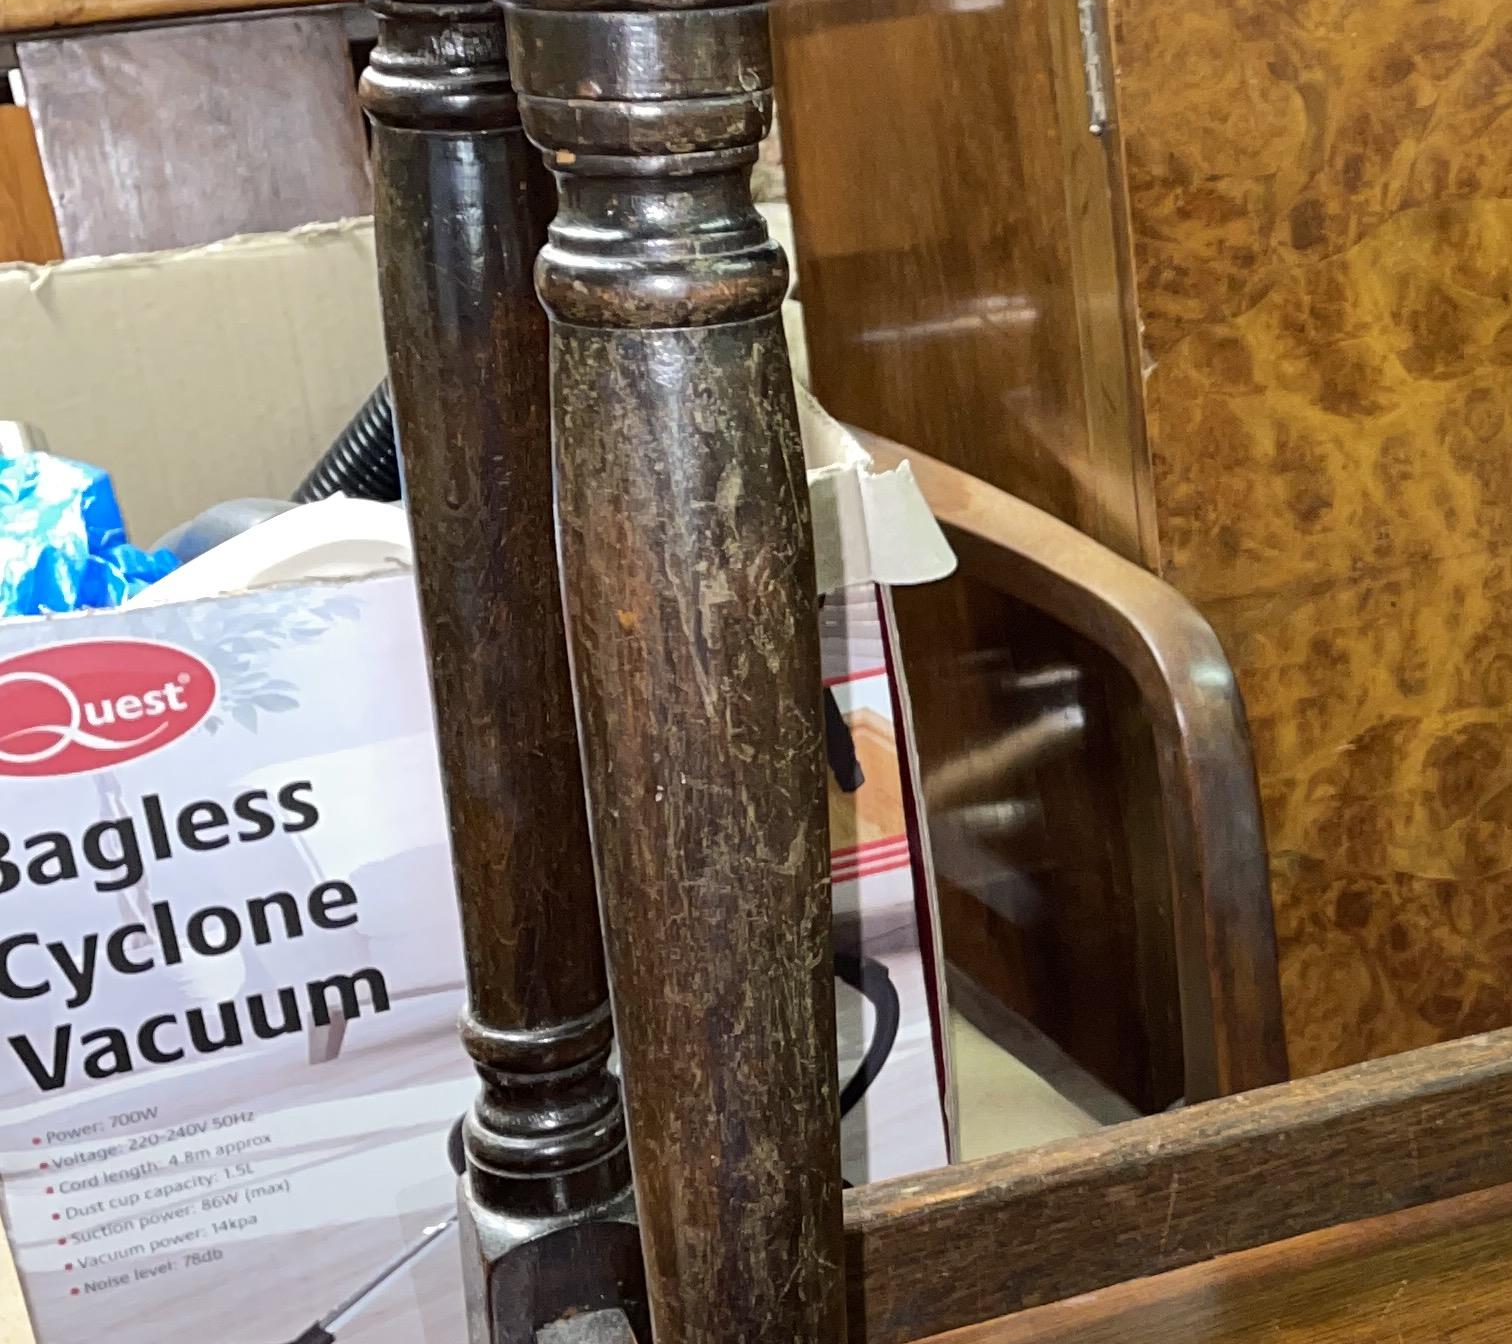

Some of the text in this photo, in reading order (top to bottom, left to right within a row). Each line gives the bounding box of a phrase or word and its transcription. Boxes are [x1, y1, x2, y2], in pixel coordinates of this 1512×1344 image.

[0, 880, 358, 1009] Cyclone
[8, 966, 390, 1092] Vacuum
[46, 1107, 158, 1144] Power: 700W
[53, 1113, 254, 1169] Voltage: 220-240V 50Hz
[59, 1175, 99, 1194] Cord
[169, 1147, 211, 1167] 4.8m
[215, 1134, 272, 1156] approx
[66, 1163, 255, 1220] Dust cup capacity: 1.5L
[70, 1179, 290, 1245] Suction power: 86W (max)
[77, 1214, 258, 1269] Vacuum power: 14kpa
[84, 1247, 224, 1294] Noise level: 78db
